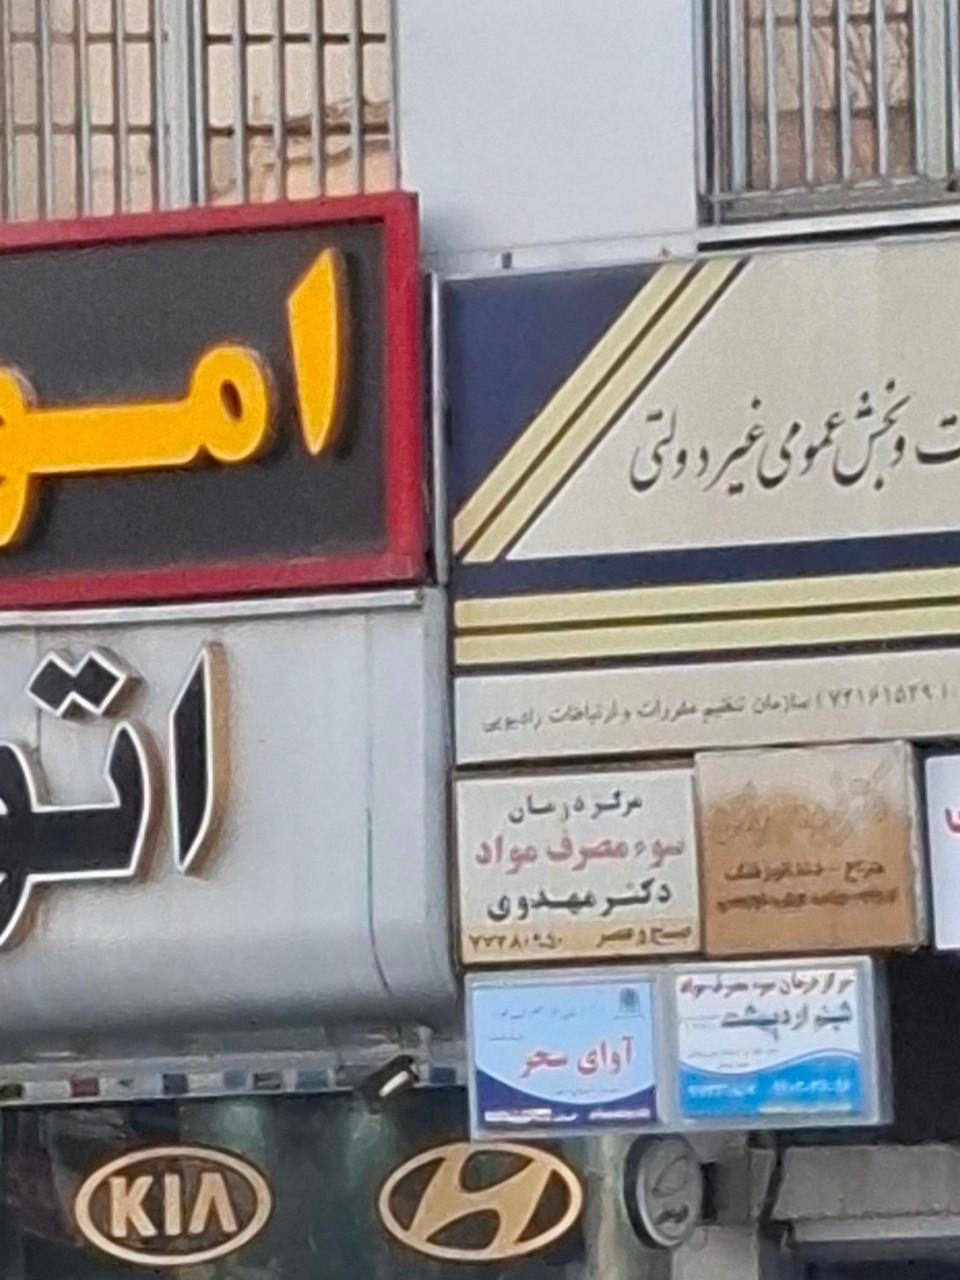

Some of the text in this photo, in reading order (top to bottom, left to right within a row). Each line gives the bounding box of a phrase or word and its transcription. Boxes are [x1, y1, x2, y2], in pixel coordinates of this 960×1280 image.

[628, 403, 711, 493] دولتی
[755, 410, 844, 490] عمومی
[832, 378, 914, 492] بخش
[753, 690, 809, 717] سازمان
[590, 789, 644, 821] مرکز
[474, 836, 538, 876] مواد
[486, 888, 598, 923] مهدوی
[600, 876, 673, 918] دکتر
[520, 1035, 637, 1080] آوای سحر
[108, 1171, 239, 1239] KIA
